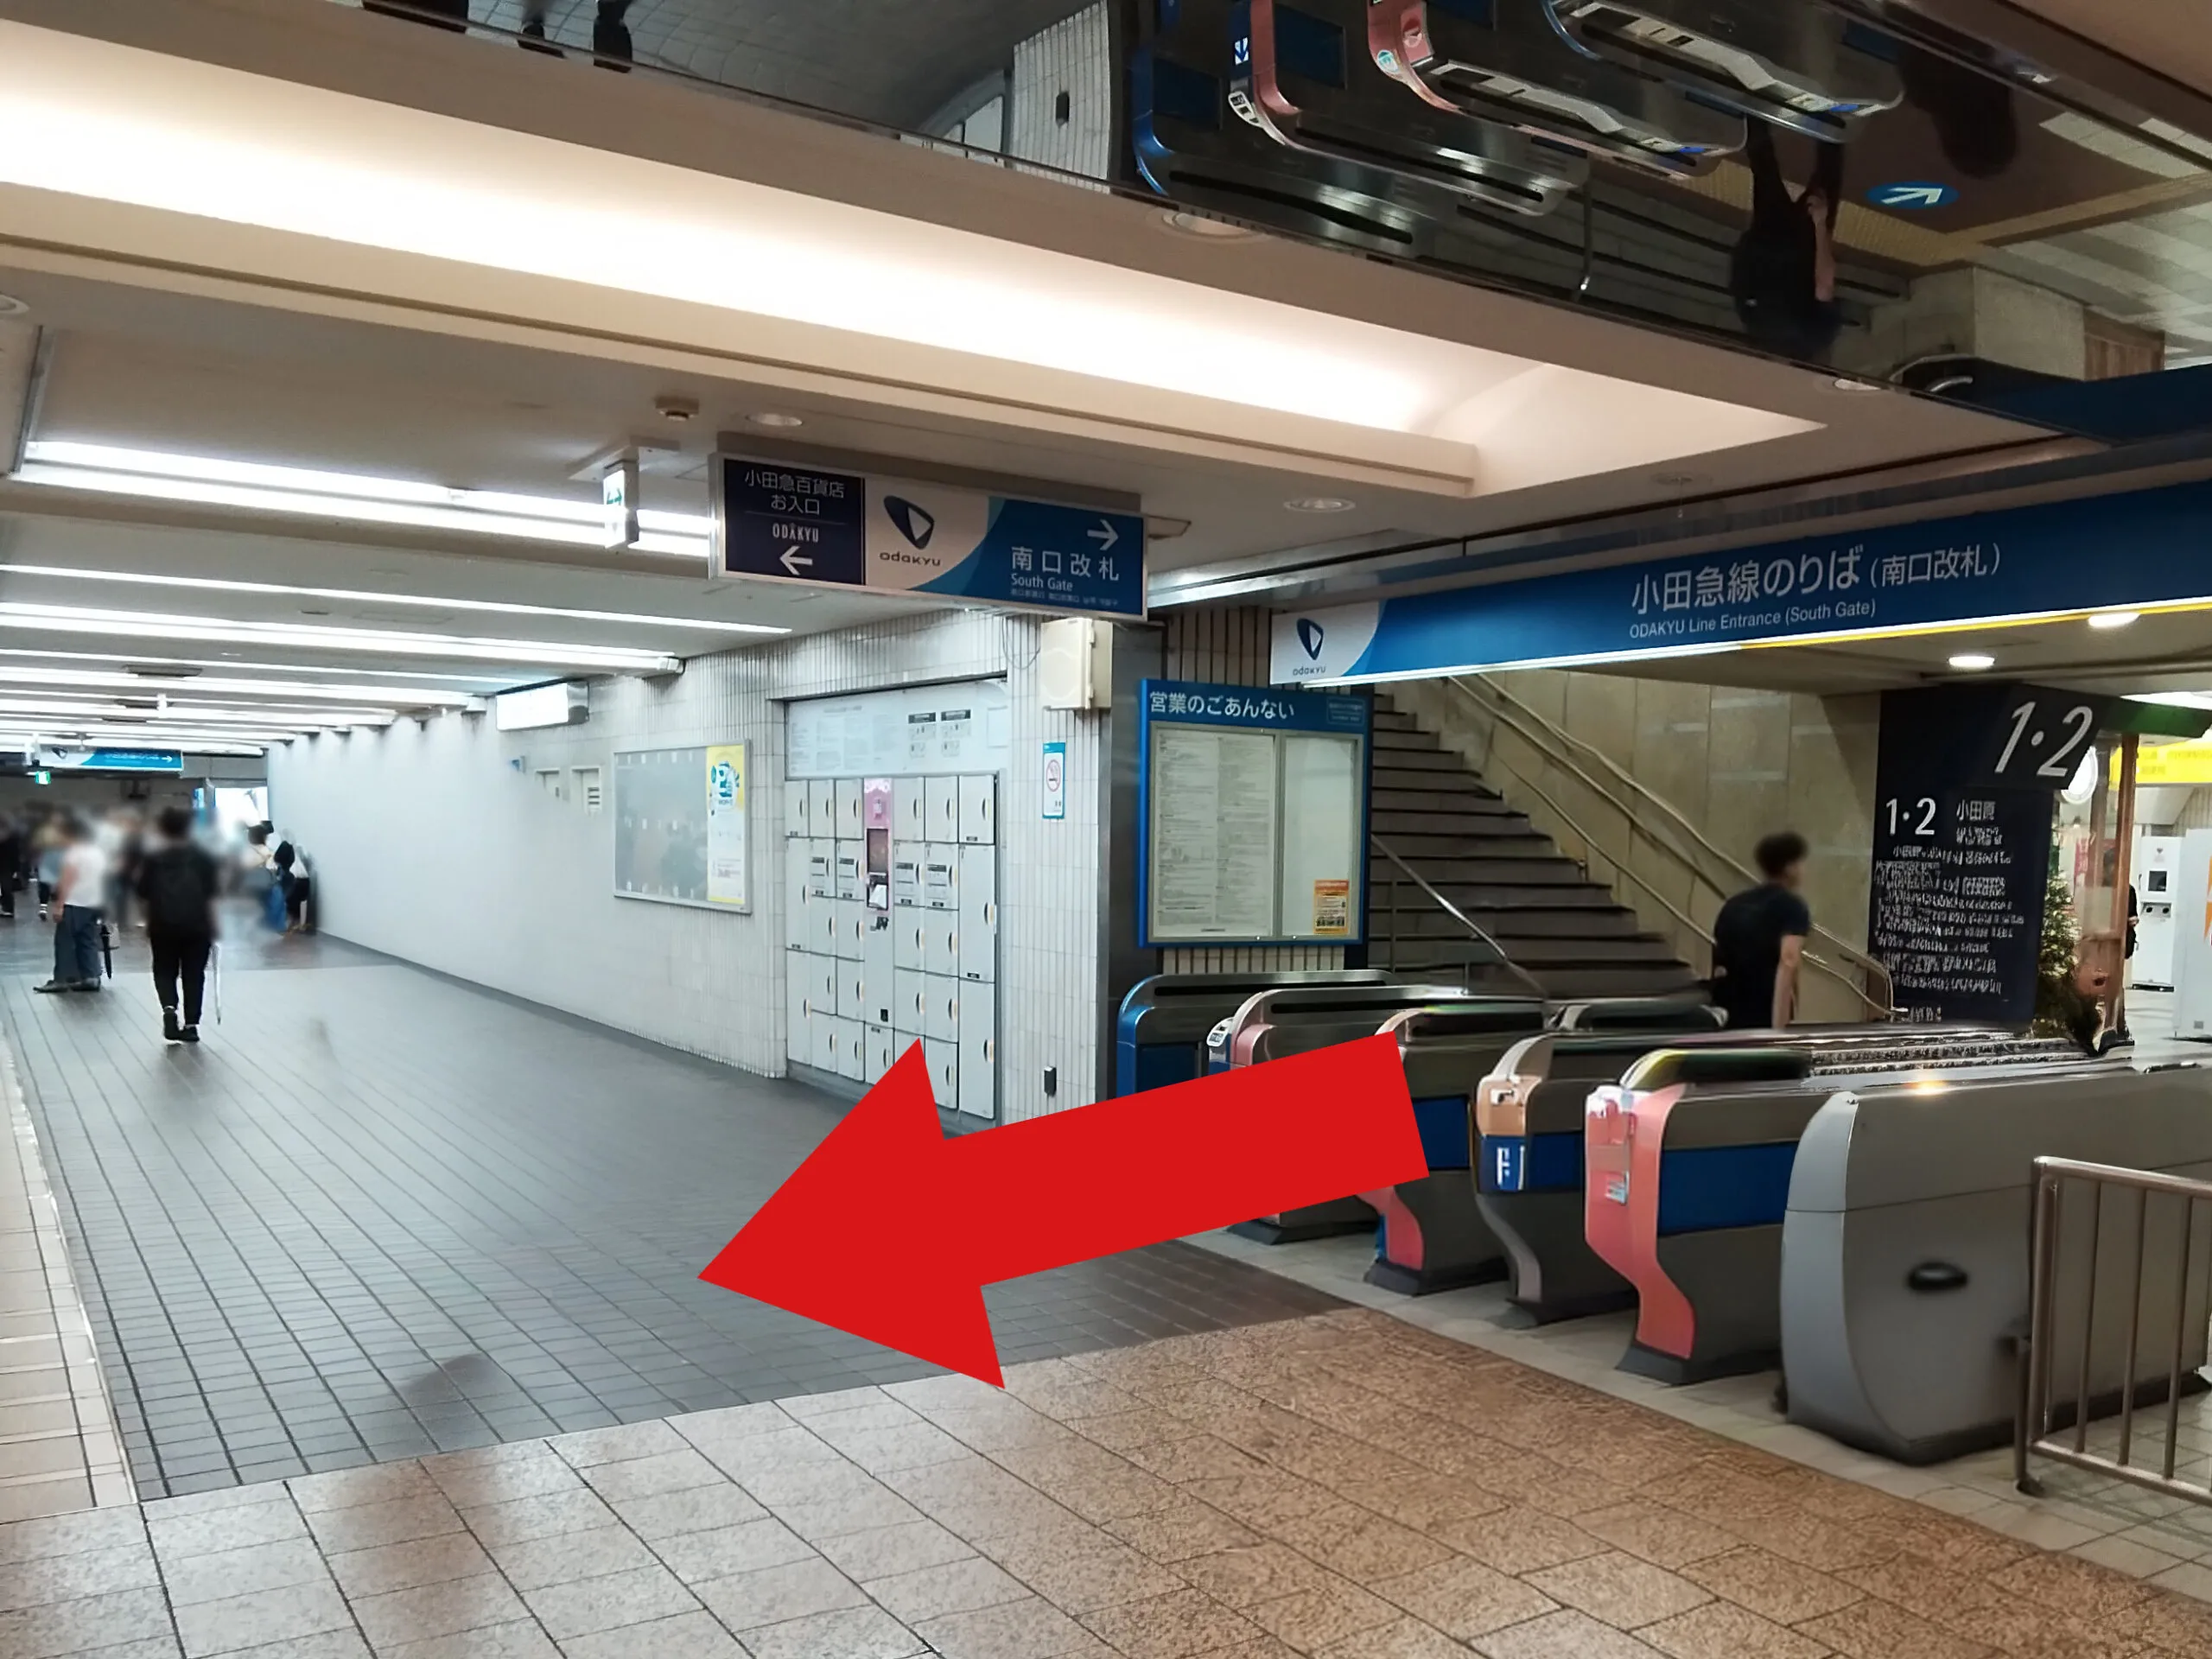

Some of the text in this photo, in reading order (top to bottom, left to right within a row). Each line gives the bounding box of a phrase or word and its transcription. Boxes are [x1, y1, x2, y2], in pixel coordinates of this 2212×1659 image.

[745, 469, 845, 499] 小田急百貨店
[771, 494, 820, 515] お入口
[772, 522, 819, 543] ODAKYU
[1011, 546, 1120, 582] 南口改札
[1011, 573, 1074, 592] South Gate
[1630, 598, 1876, 639] ODAKYU Line Entrance (South Gate)
[1150, 691, 1295, 720] 営業のごあんない
